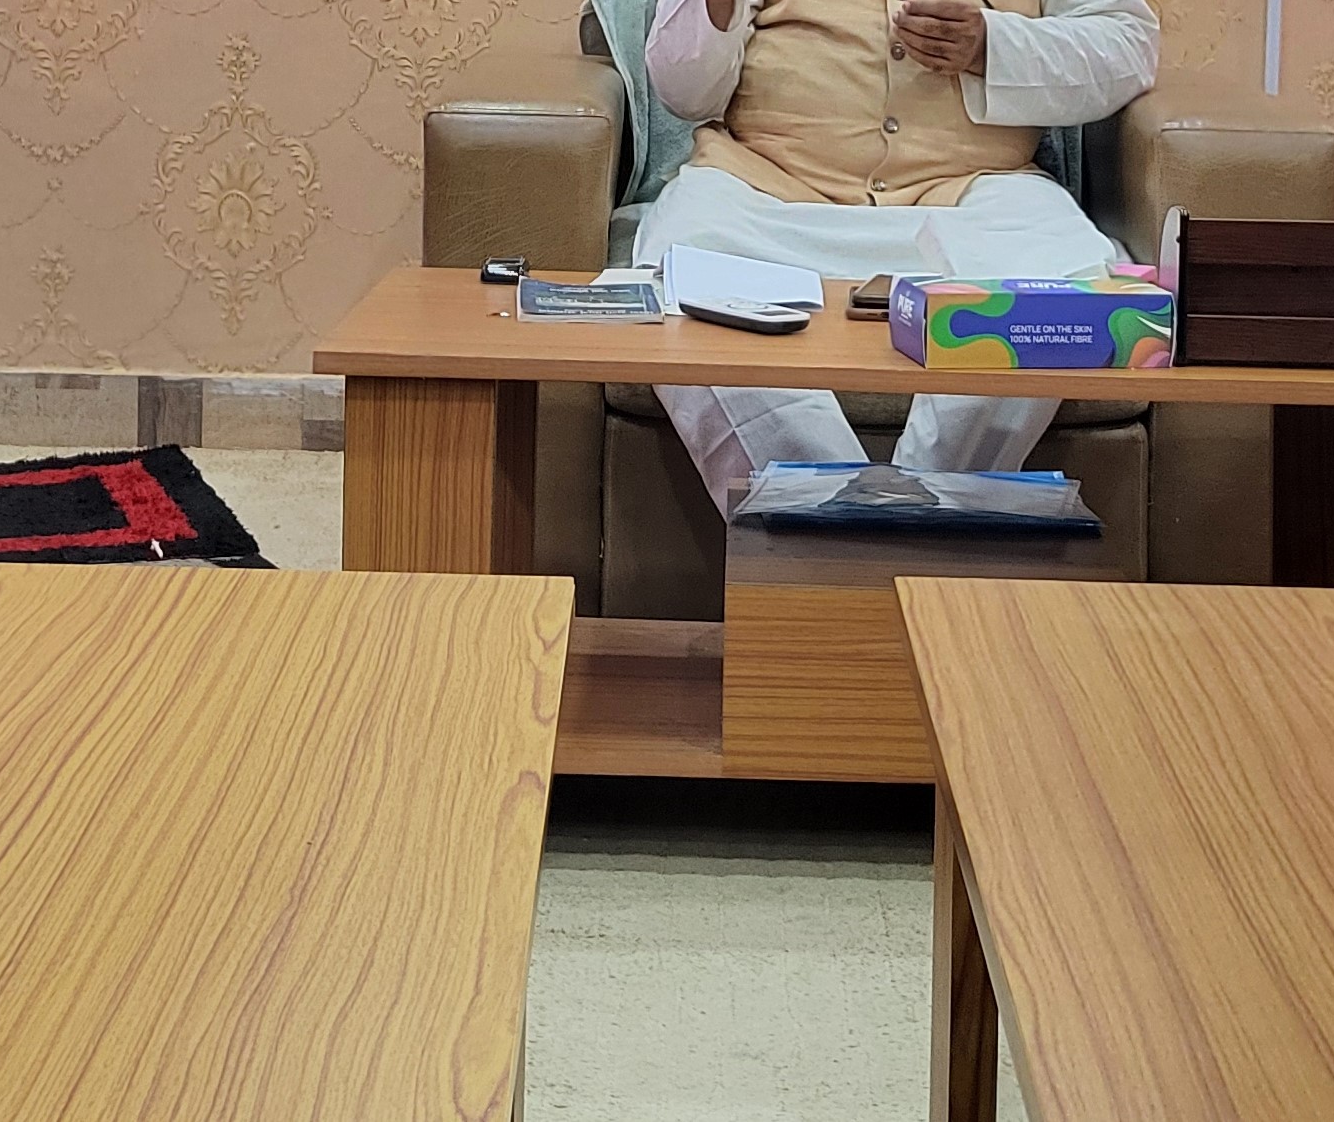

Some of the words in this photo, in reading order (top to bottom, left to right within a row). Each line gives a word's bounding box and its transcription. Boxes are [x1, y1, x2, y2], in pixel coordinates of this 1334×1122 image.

[897, 293, 915, 318] PURE
[1009, 324, 1041, 334] GENTLE
[1042, 324, 1055, 334] ON
[1056, 324, 1072, 334] THE
[1073, 325, 1093, 334] SKIN
[1009, 334, 1032, 344] 100%
[1033, 334, 1070, 344] NATURAL
[1070, 334, 1093, 344] FIBRE
